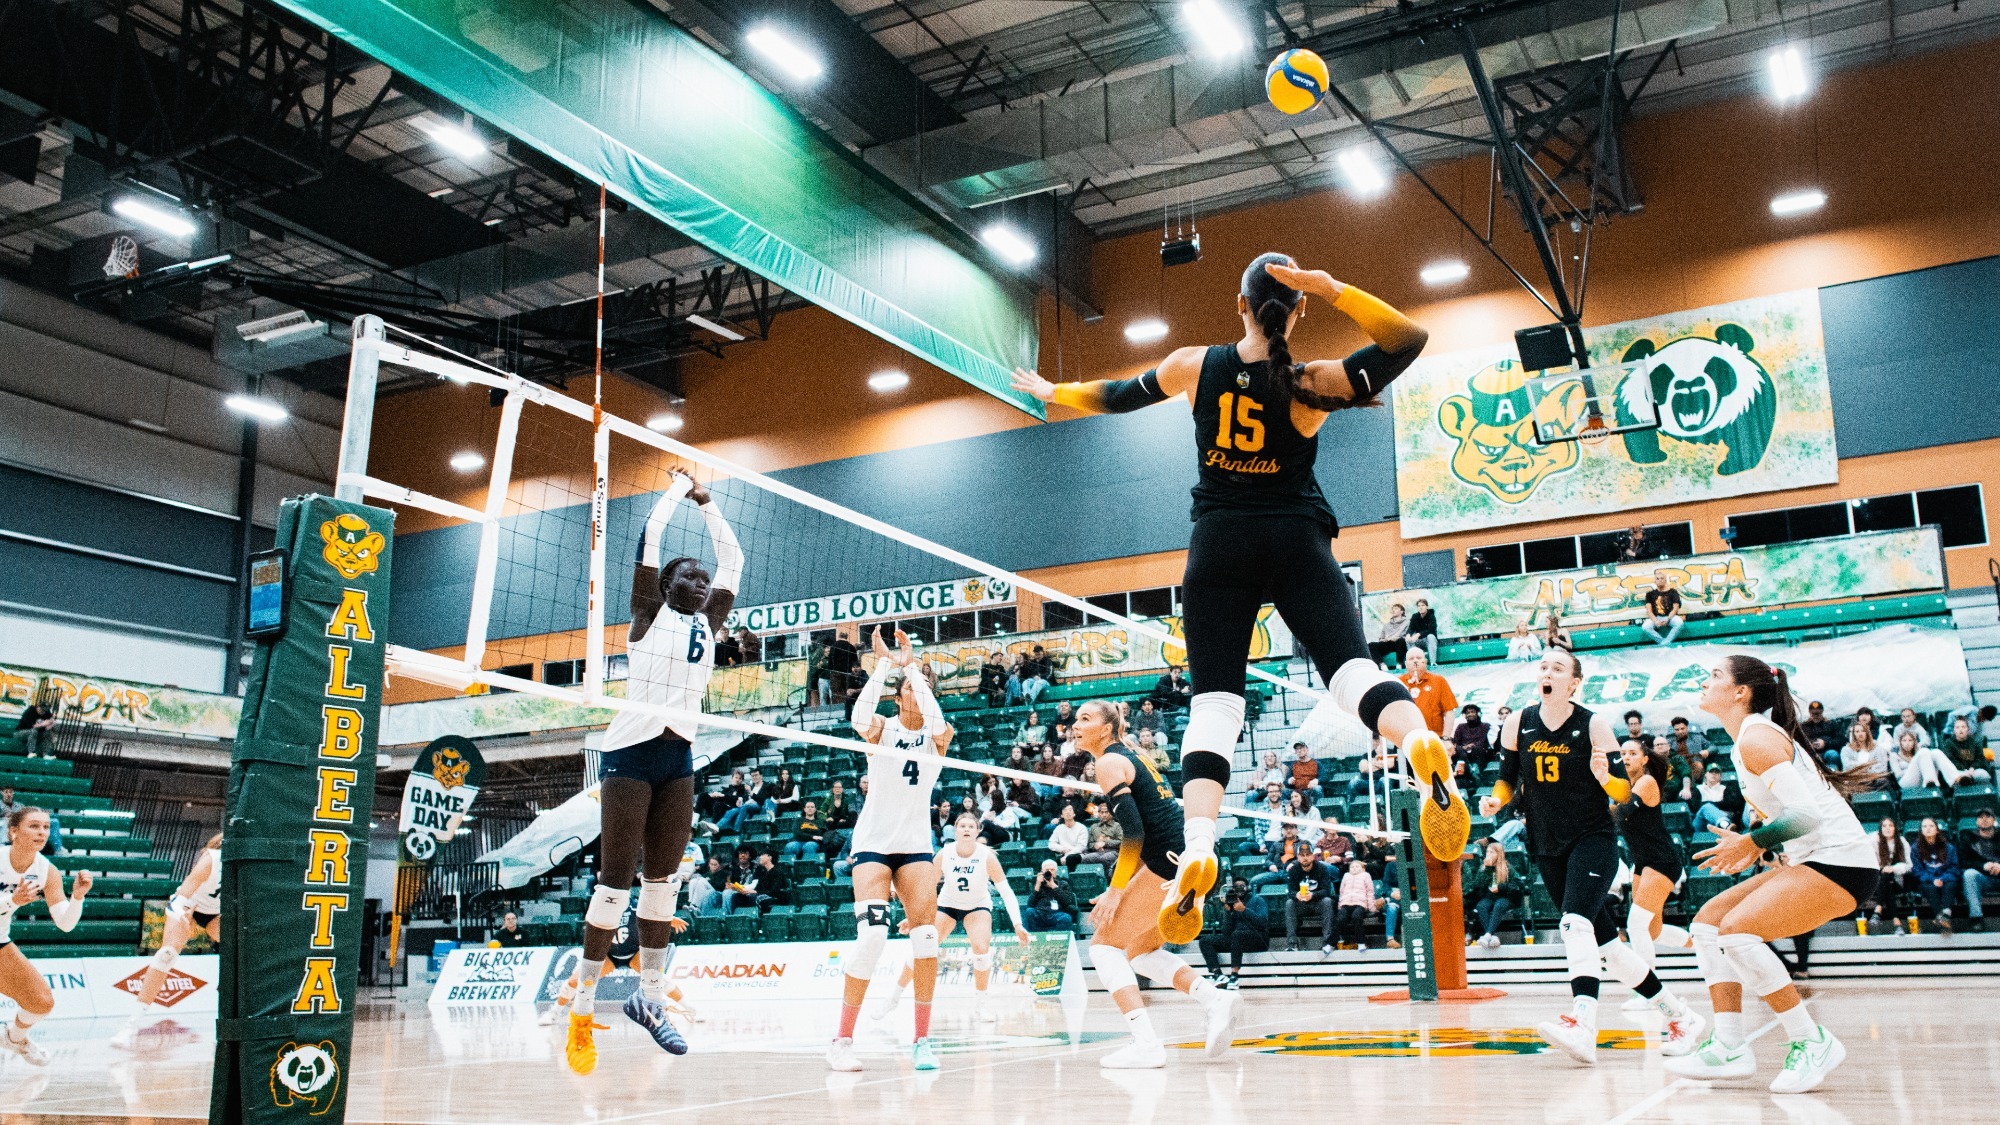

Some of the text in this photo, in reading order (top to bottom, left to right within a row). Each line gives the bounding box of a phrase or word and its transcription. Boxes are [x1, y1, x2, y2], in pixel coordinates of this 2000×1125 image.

[1495, 398, 1517, 422] A
[1216, 392, 1265, 452] 15
[1205, 449, 1280, 473] Pandas
[345, 532, 356, 543] A
[747, 583, 955, 631] CLUB LOUNGE
[687, 629, 706, 663] 6
[1528, 740, 1571, 754] Alberta
[902, 759, 920, 786] 4
[1535, 755, 1560, 782] 13
[291, 587, 376, 1014] ALBERTA
[411, 786, 464, 813] GAME
[412, 806, 452, 831] DAY
[953, 865, 975, 874] MRU
[957, 877, 970, 892] 2
[464, 951, 535, 967] BIG ROCK
[672, 963, 787, 979] CANADIAN
[1031, 971, 1060, 983] GREEN
[1032, 966, 1046, 975] GO
[43, 973, 86, 989] TIN
[166, 977, 197, 991] STEEL
[713, 980, 780, 989] BREWHOUSE
[448, 985, 522, 1000] BREWERY
